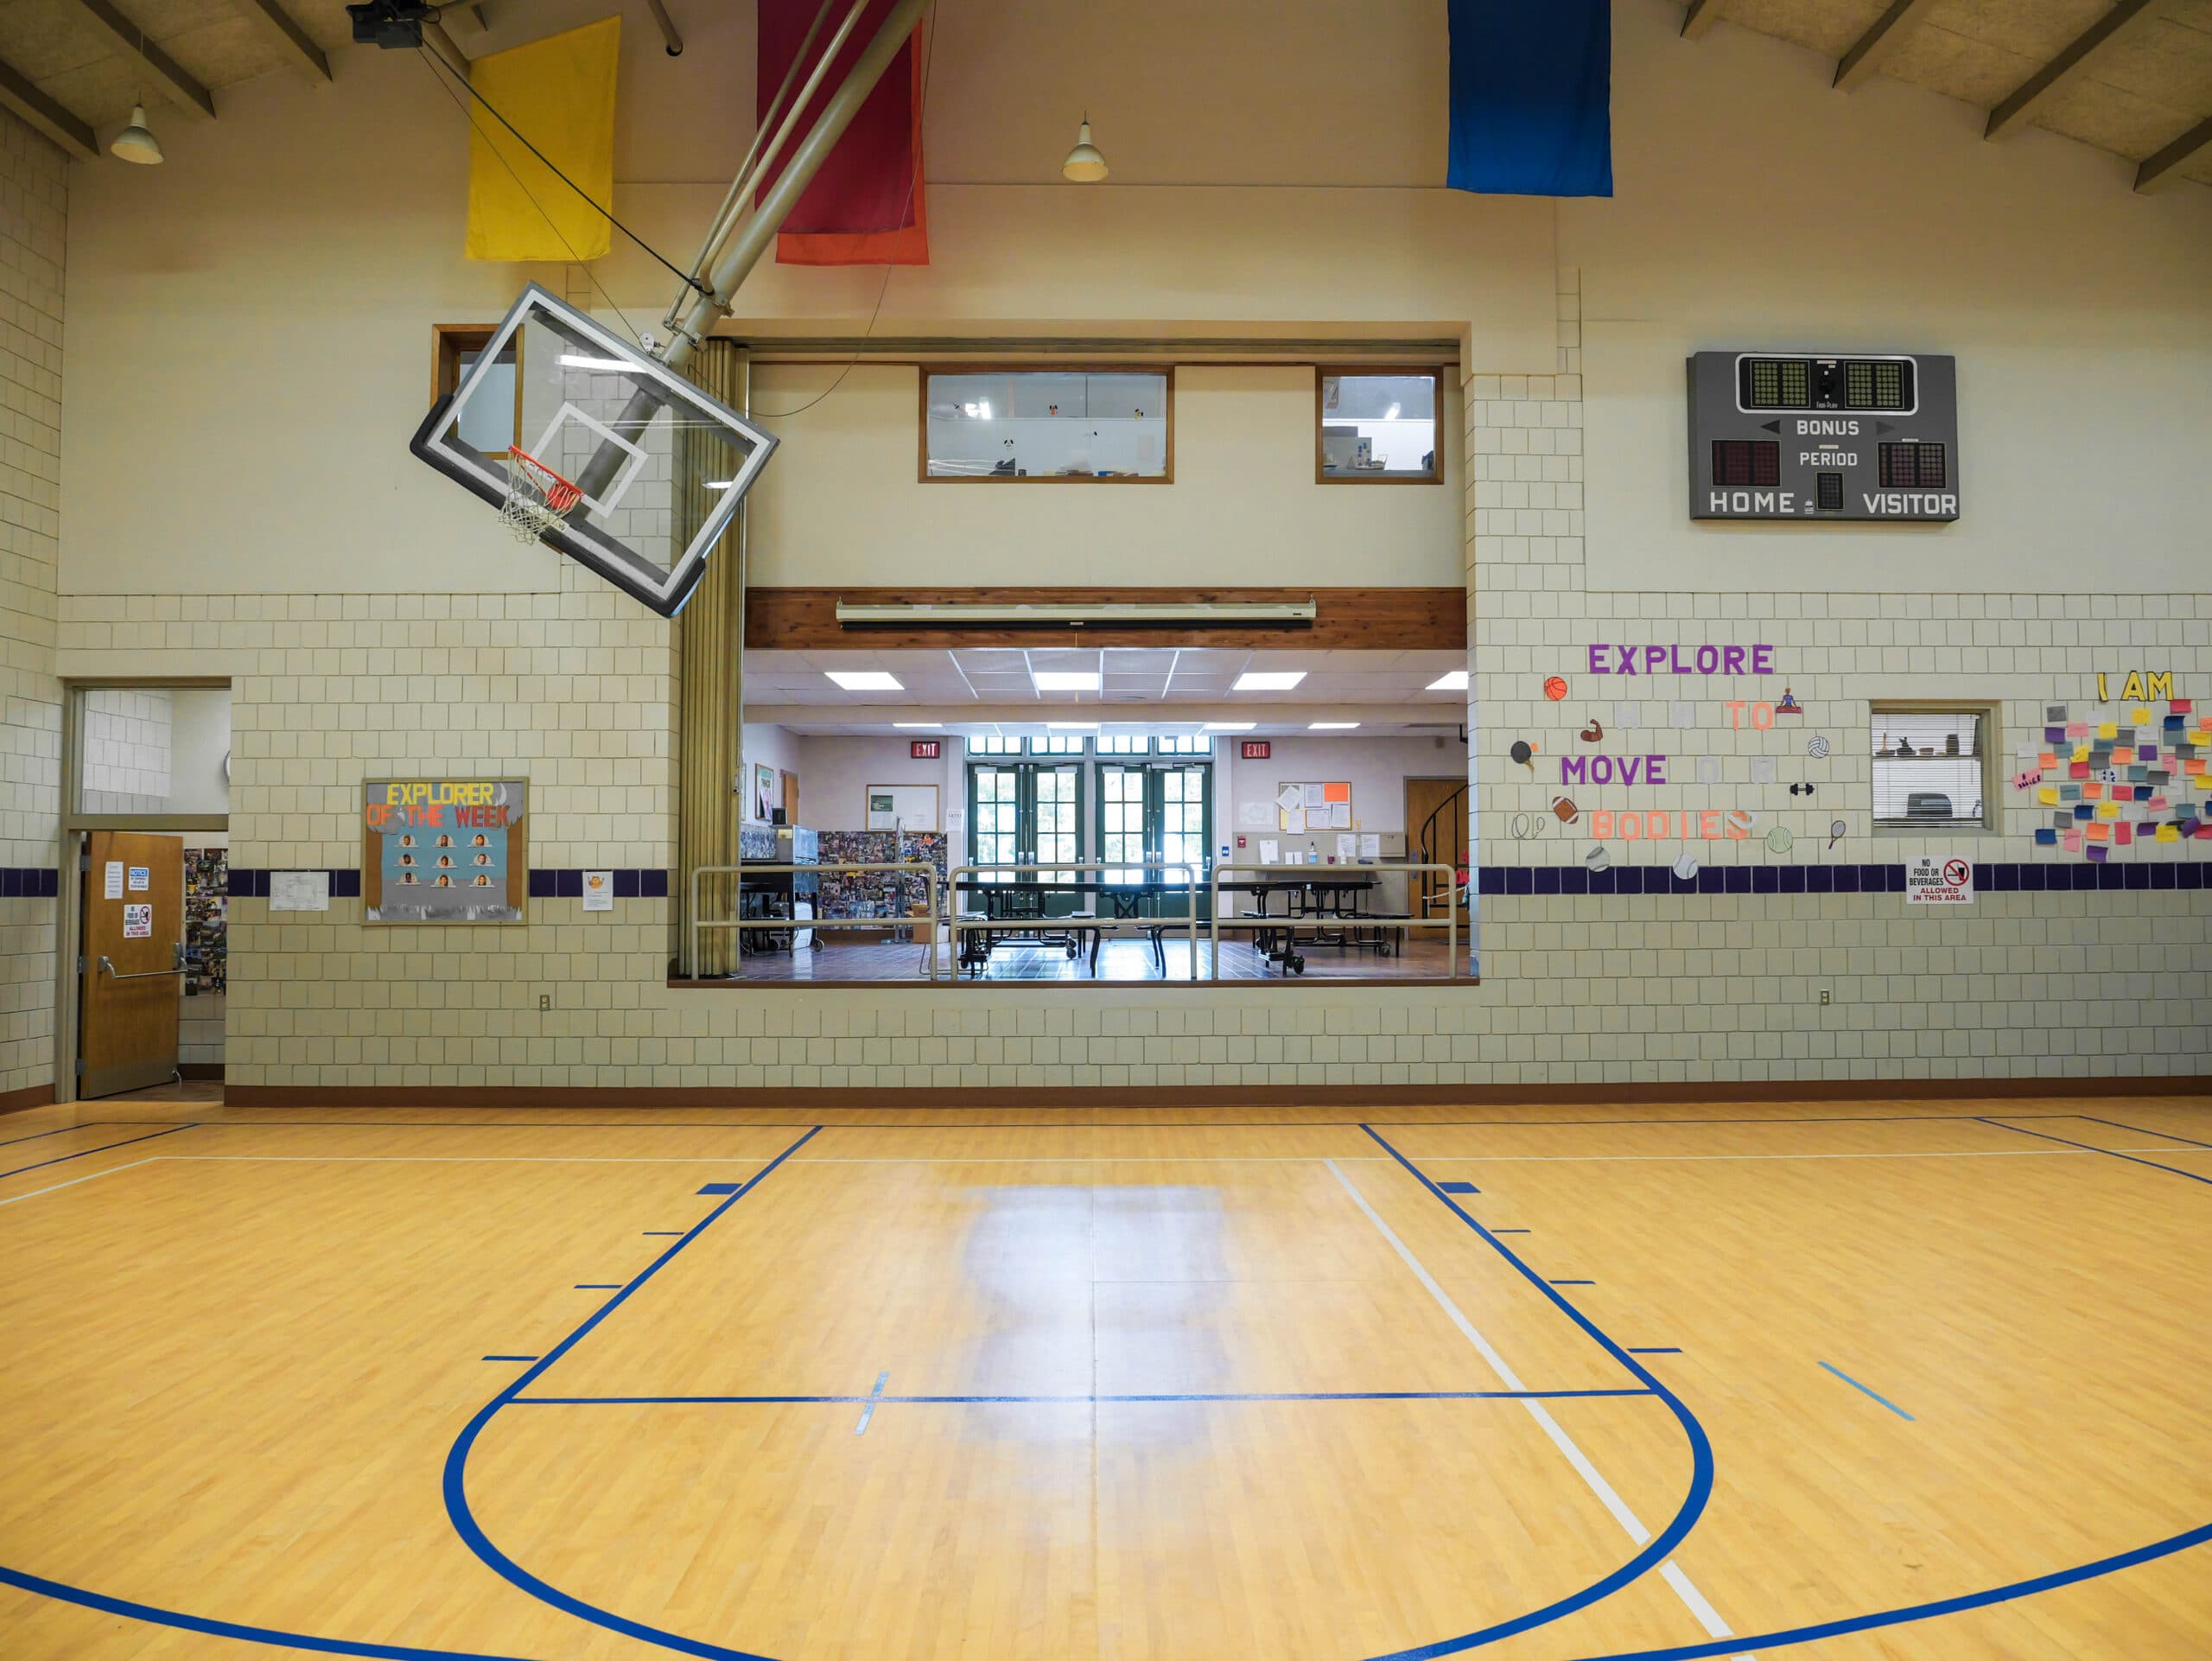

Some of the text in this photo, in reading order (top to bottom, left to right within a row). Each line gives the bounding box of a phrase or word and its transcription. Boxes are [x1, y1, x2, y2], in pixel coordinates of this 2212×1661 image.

[1796, 420, 1859, 436] BONUS
[1800, 452, 1858, 466] PERIOD
[1710, 492, 1795, 512] HOME
[1863, 493, 1956, 514] VISITOR
[1589, 644, 1774, 676] EXPLORE
[2096, 671, 2174, 702] I AM
[1726, 701, 1774, 730] TO
[916, 742, 937, 757] EXIT
[1247, 743, 1266, 757] EXIT
[1561, 755, 1667, 786] MOVE
[386, 782, 494, 805] EXPLORER
[366, 804, 511, 828] OF THE WEEK
[1592, 810, 1750, 840] BODIES
[1913, 868, 1939, 876] FOOD OR
[1922, 858, 1930, 867] NO
[1909, 877, 1944, 886] BEVERAGES
